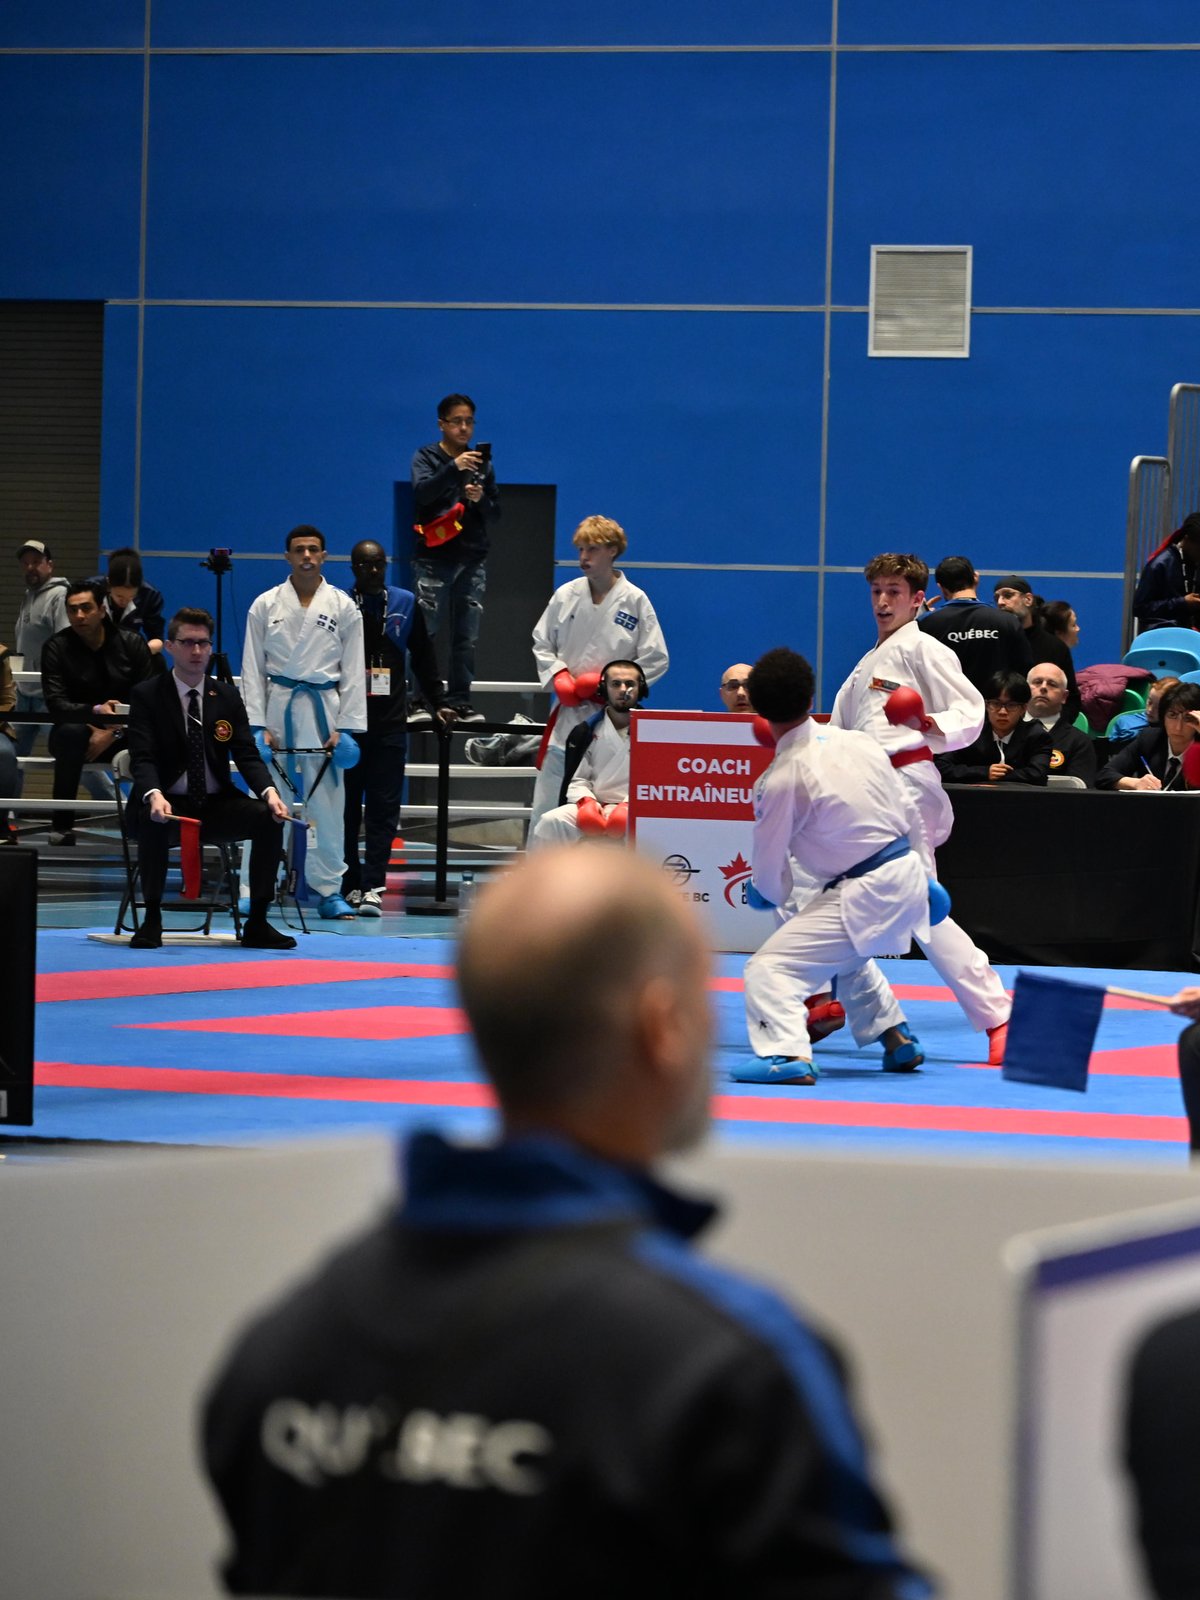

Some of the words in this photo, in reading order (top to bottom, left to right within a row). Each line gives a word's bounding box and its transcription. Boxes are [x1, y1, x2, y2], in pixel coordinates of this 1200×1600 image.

[947, 628, 999, 643] QUÉBEC
[677, 757, 751, 775] COACH
[636, 782, 753, 804] ENTRAÎNEU
